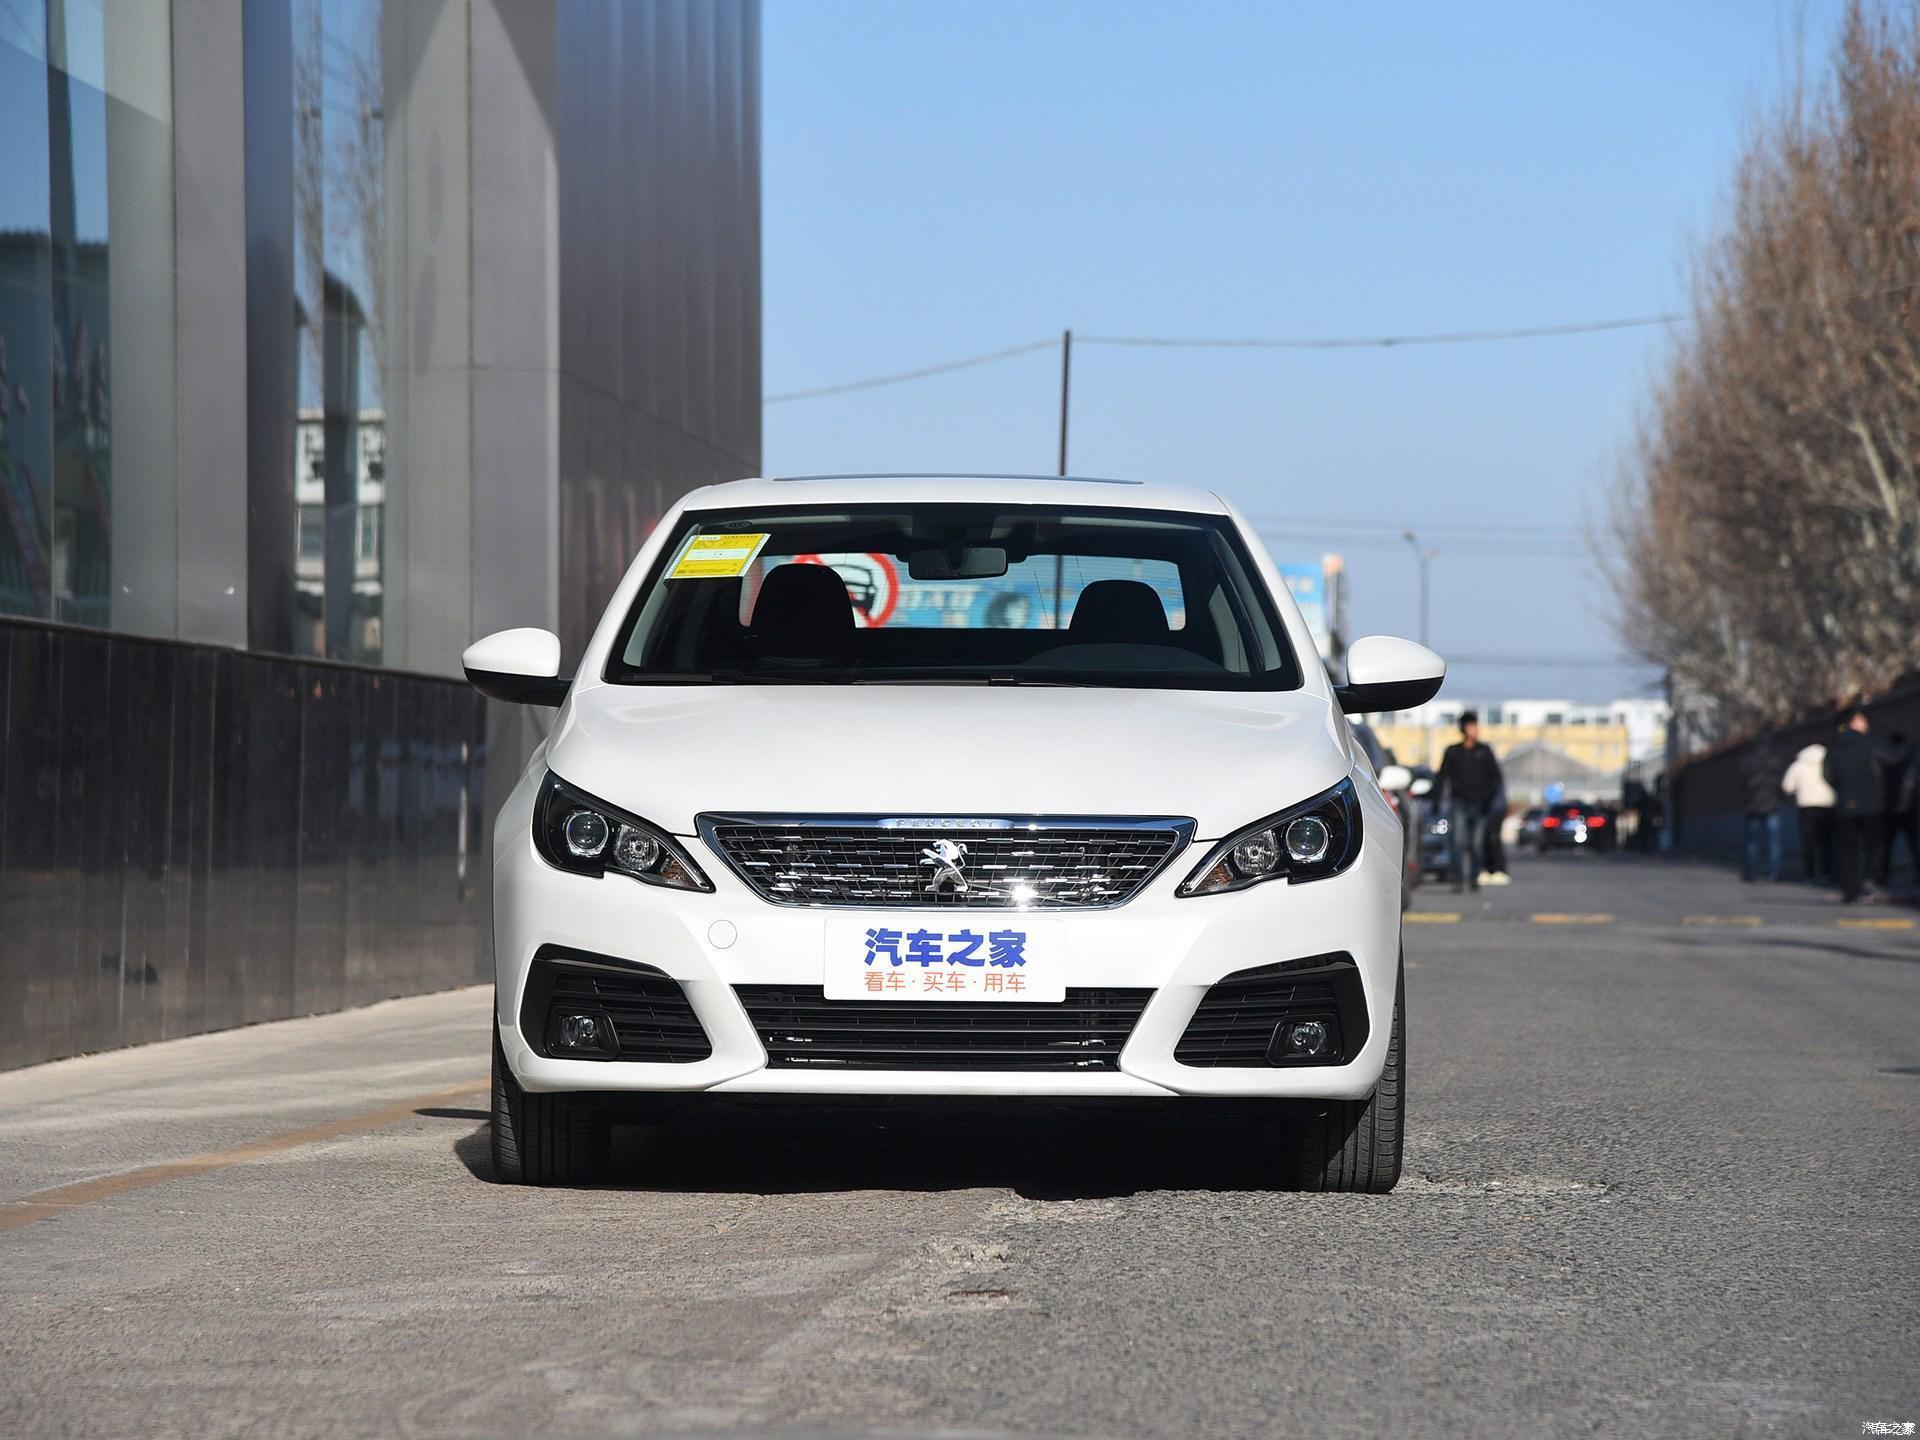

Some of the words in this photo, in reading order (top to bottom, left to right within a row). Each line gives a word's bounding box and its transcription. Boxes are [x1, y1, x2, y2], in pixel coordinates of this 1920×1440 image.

[895, 820, 994, 828] PEUGEOT
[864, 928, 1026, 969] 汽车之家
